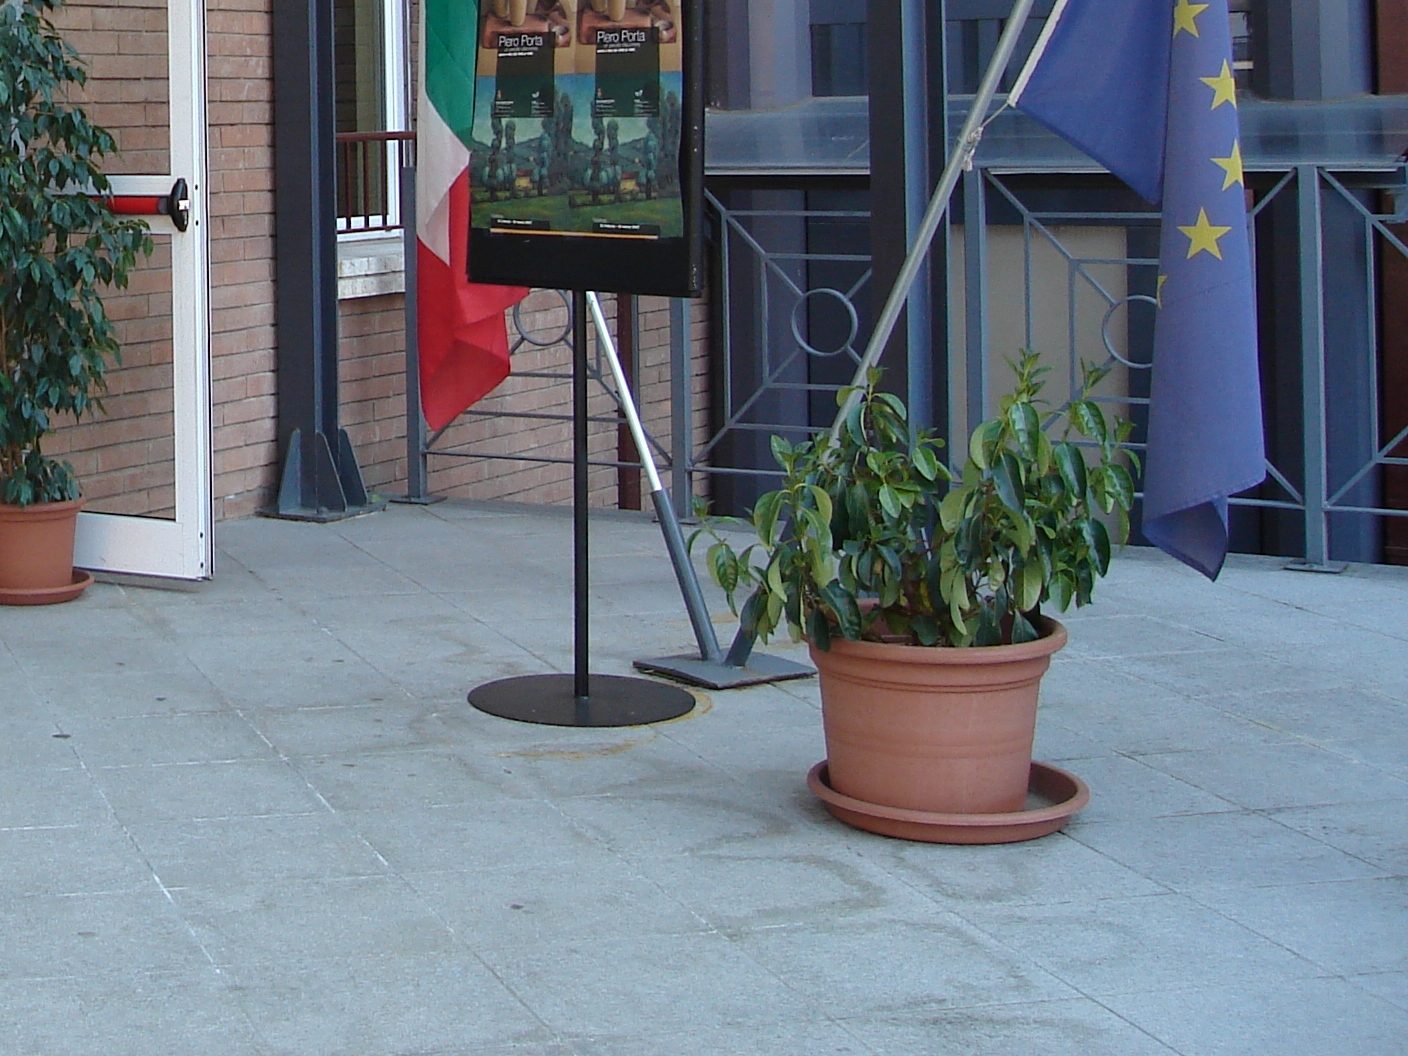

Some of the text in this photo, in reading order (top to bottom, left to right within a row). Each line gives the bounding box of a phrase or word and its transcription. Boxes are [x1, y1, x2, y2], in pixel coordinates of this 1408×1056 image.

[498, 34, 543, 47] Piero Porta
[597, 29, 646, 43] Piero Porta
